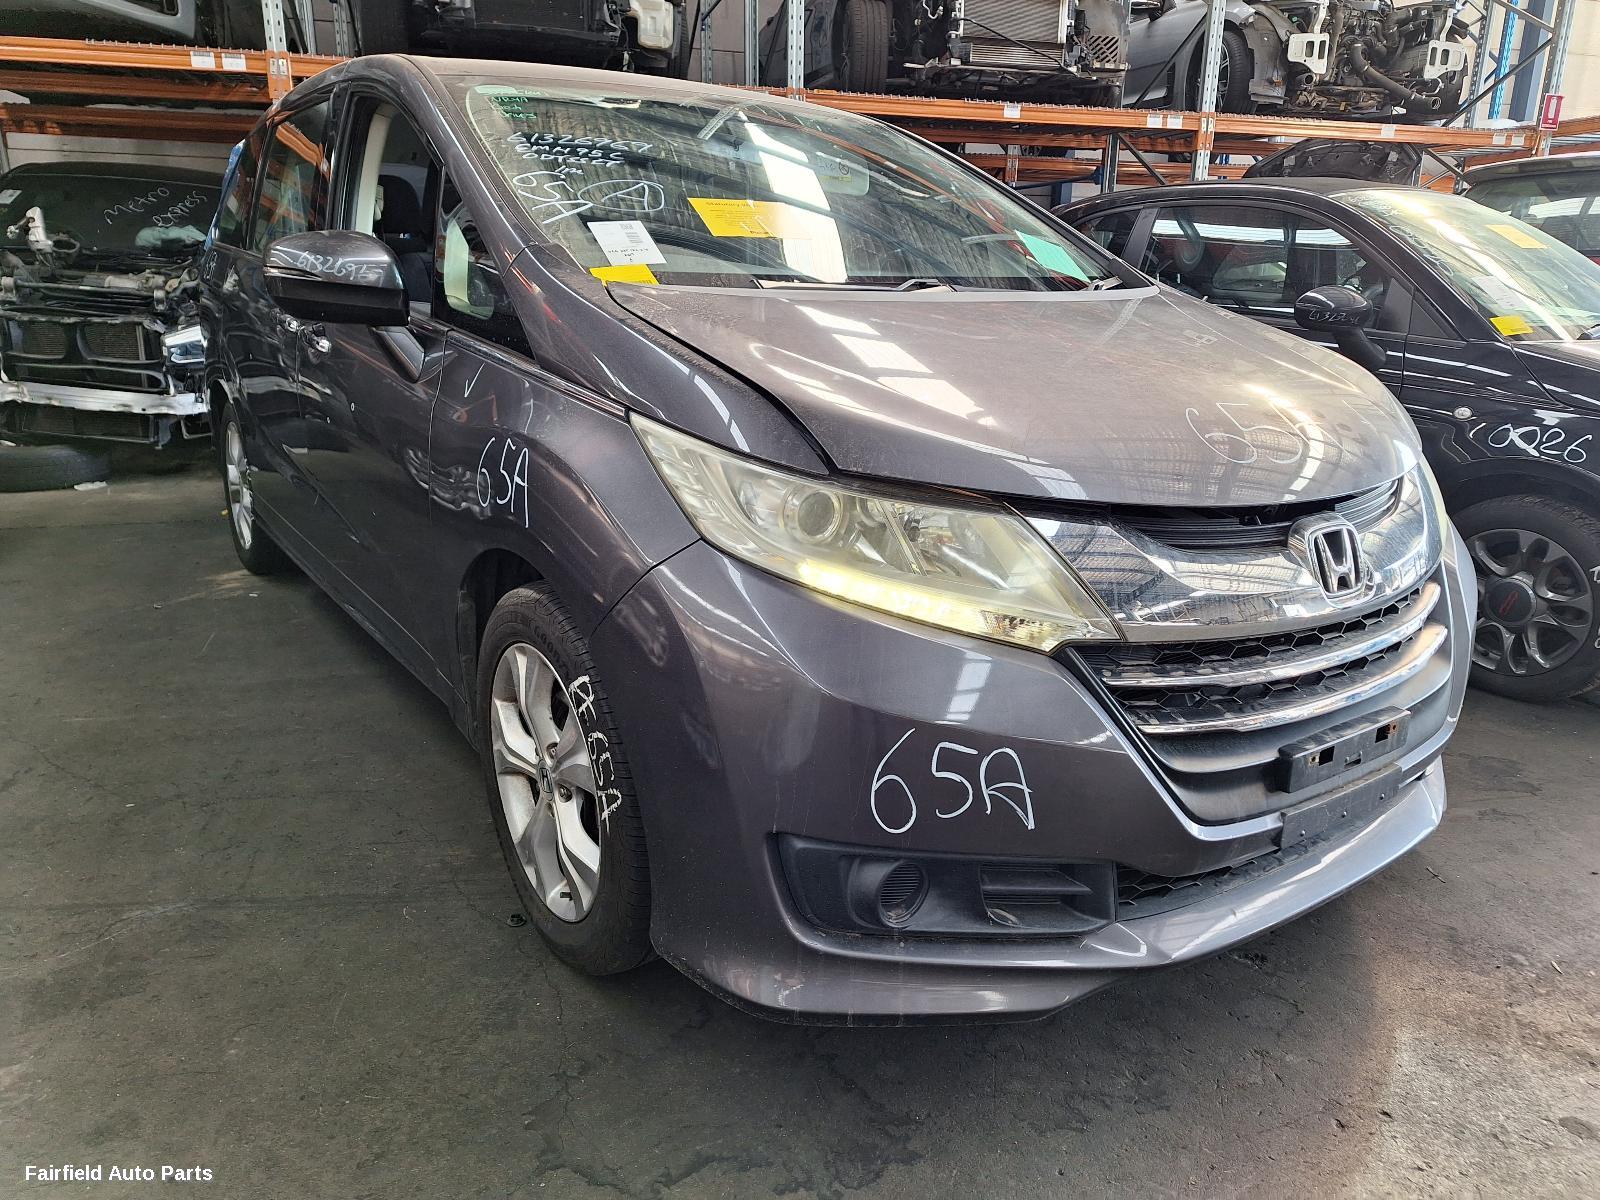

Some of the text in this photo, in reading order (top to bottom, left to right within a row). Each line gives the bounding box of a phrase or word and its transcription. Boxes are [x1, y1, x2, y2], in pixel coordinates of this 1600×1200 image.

[103, 187, 170, 225] Metro
[476, 436, 529, 529] 65A
[870, 727, 1036, 834] 65A
